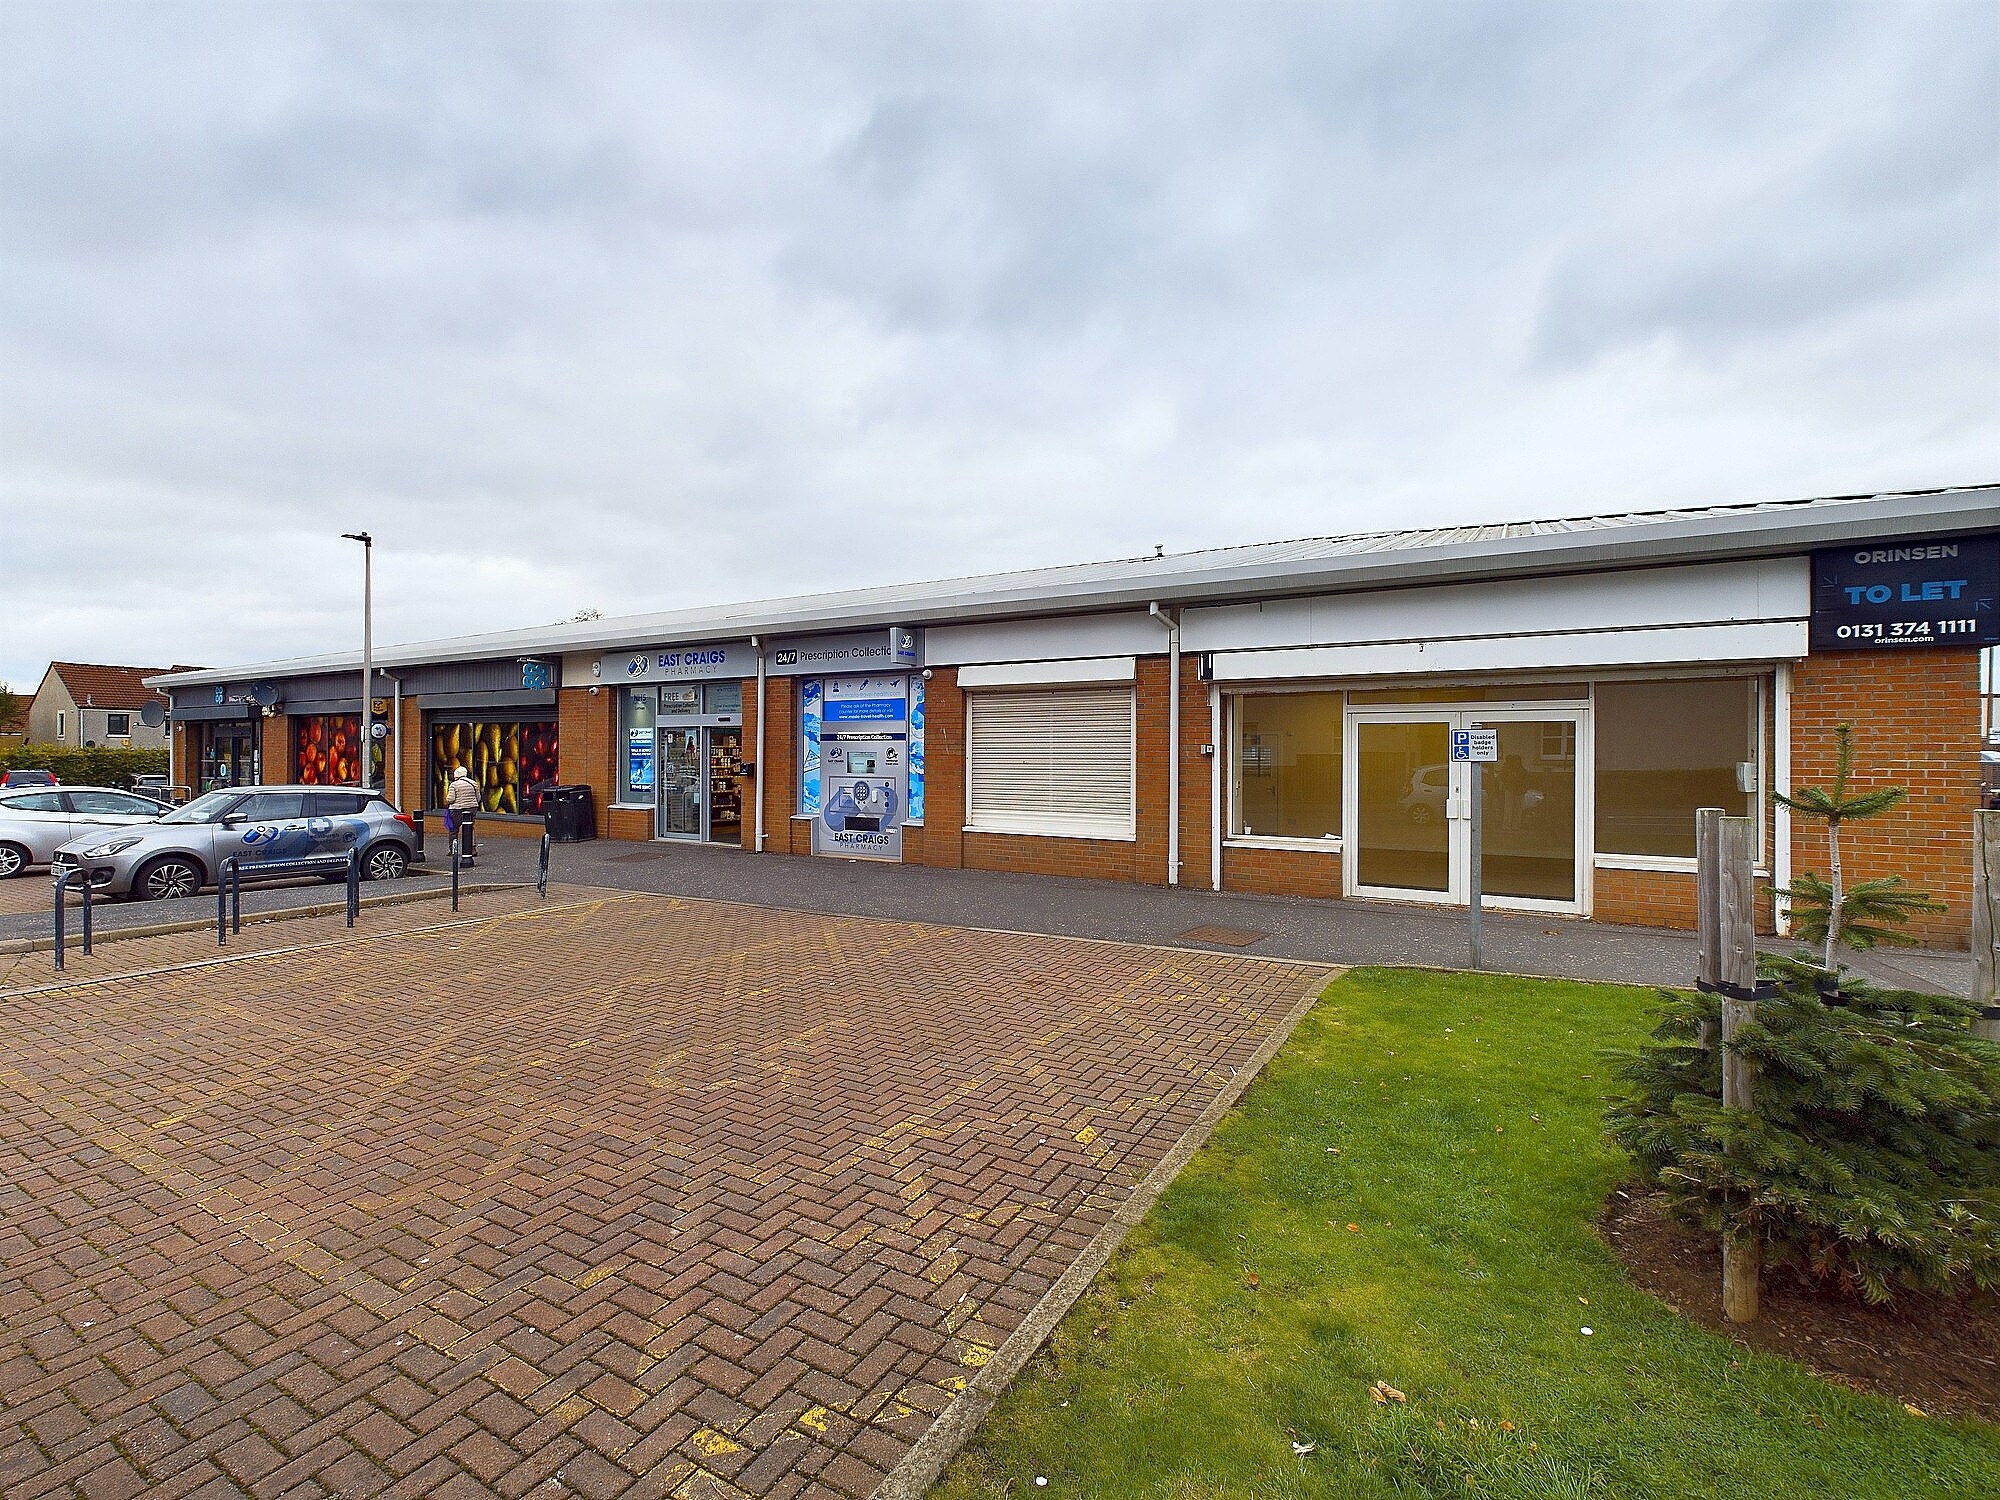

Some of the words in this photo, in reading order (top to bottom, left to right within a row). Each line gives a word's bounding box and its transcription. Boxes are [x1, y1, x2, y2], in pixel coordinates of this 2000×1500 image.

[1854, 544, 1959, 564] ORINSEN
[1844, 584, 1892, 604] TO
[1901, 579, 1968, 601] LET
[1836, 623, 1883, 638] 0131
[1890, 621, 1931, 636] 374
[1937, 619, 1977, 634] 1111
[1874, 636, 1934, 644] orinsen.com
[658, 653, 680, 667] EAST
[684, 649, 725, 666] CRAIGS
[777, 652, 796, 664] 24/7
[800, 649, 849, 661] Prescription
[851, 645, 892, 658] Collectio
[664, 665, 718, 676] PHARMACY
[664, 692, 679, 701] FREE
[834, 832, 854, 842] EAST
[855, 833, 889, 845] CRAIGS
[839, 842, 883, 851] PHARMACY
[232, 850, 253, 858] EAST
